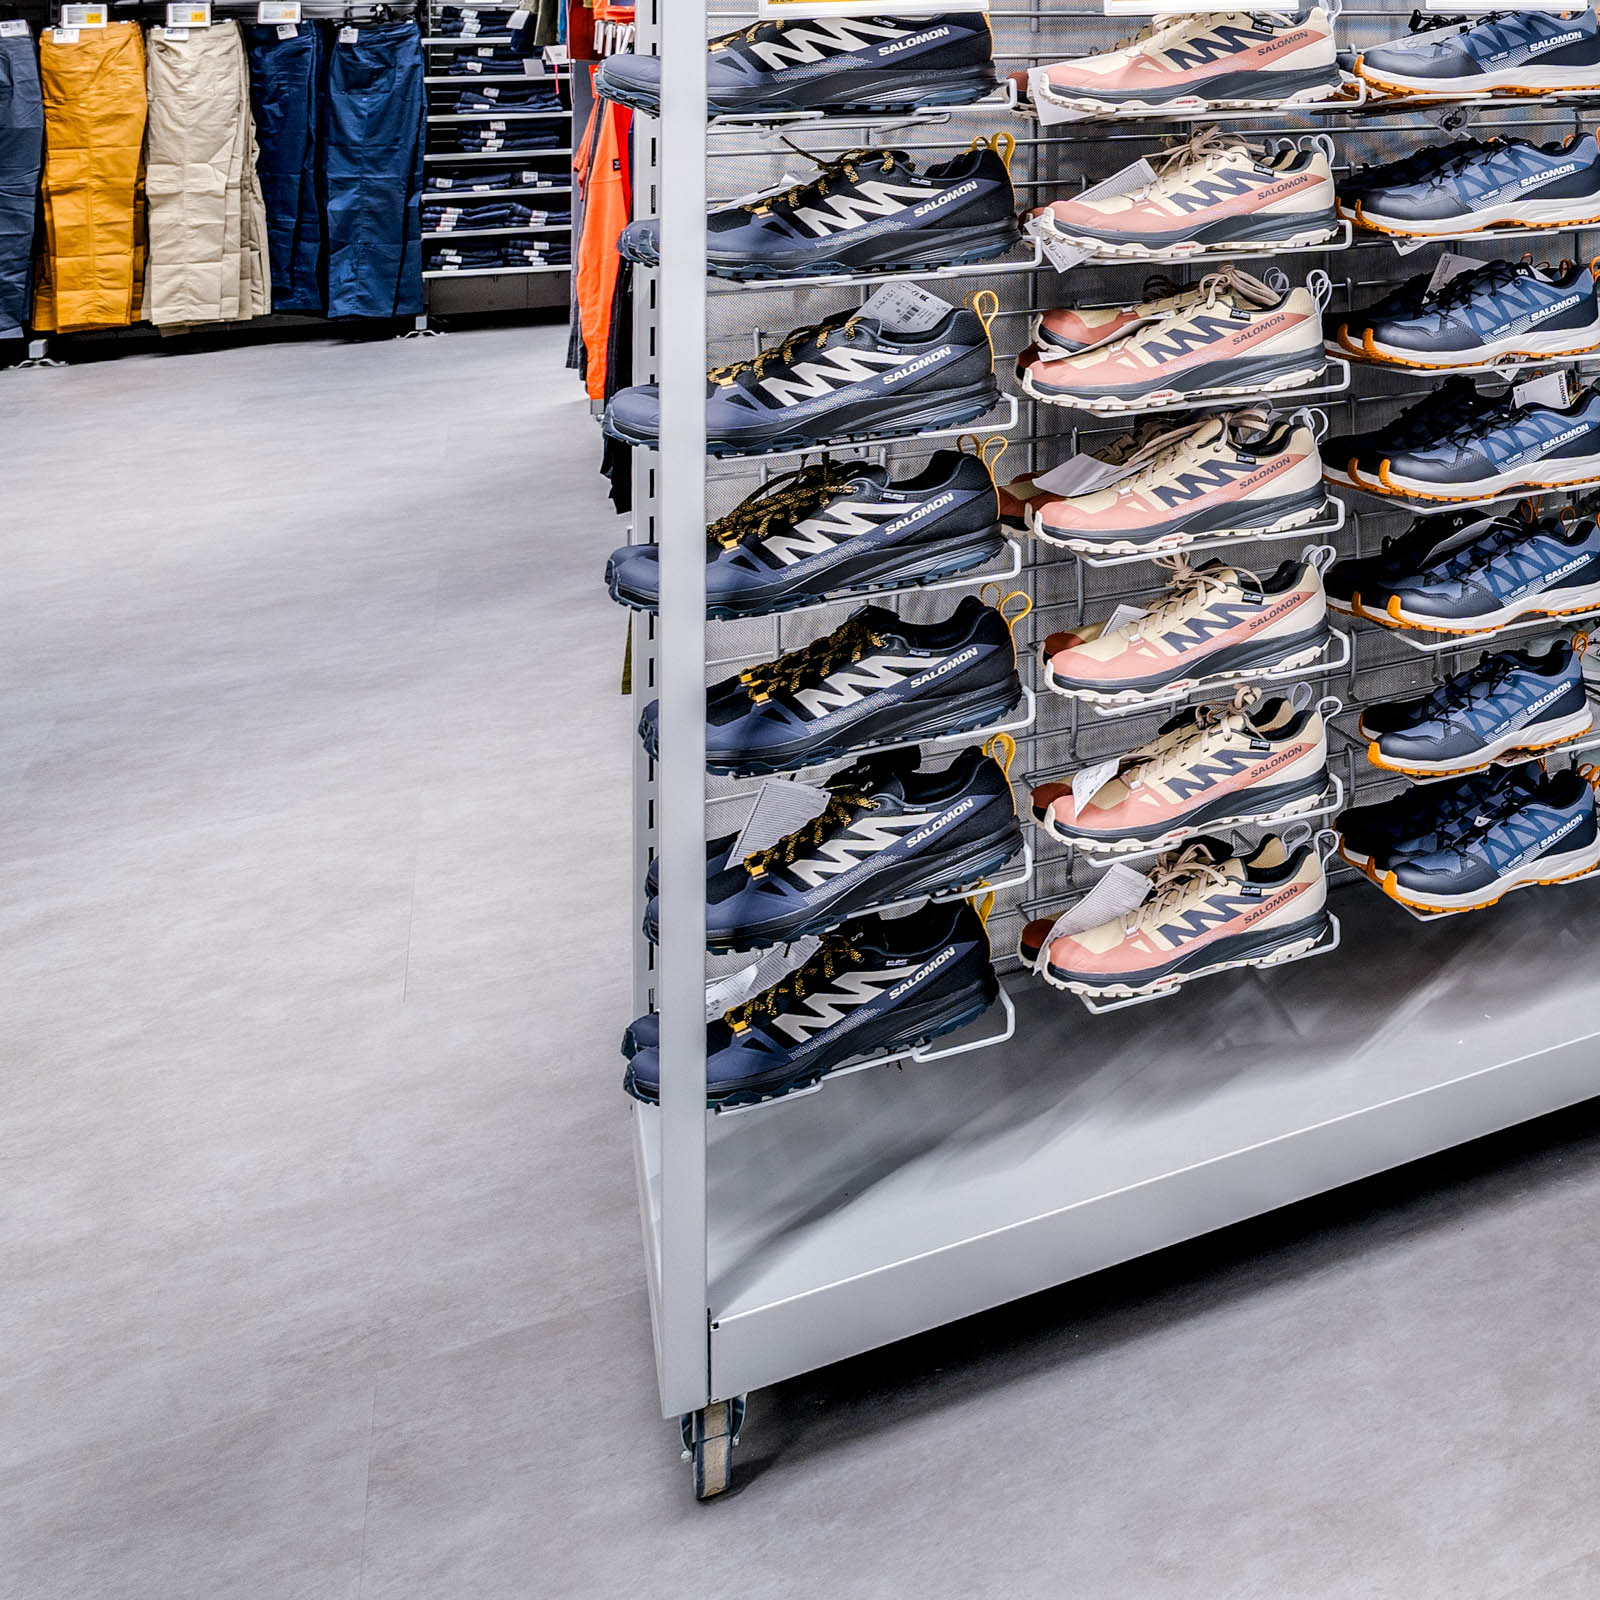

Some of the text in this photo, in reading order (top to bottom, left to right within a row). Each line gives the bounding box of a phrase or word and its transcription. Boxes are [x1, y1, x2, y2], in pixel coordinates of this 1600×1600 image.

[878, 26, 950, 57] SALOMON
[1257, 30, 1309, 57] SALOMON
[1529, 31, 1583, 53] SALOMON
[1257, 175, 1309, 200] SALOMON
[1520, 163, 1576, 188] SALOMON
[914, 180, 979, 217] SALOMON
[1530, 295, 1580, 321] SALOMON
[1232, 314, 1285, 345] SALOMON
[882, 346, 952, 385] SALOMON
[1541, 423, 1589, 451] SALOMON
[1239, 457, 1291, 490] SALOMON
[884, 493, 954, 536] SALOMON
[1544, 554, 1590, 583] SALOMON
[1249, 593, 1301, 631] SALOMON
[910, 646, 979, 688] SALOMON
[1526, 681, 1571, 715] SALOMON
[1250, 745, 1303, 780] SALOMON
[906, 798, 974, 848] SALOMON
[1540, 814, 1583, 848] SALOMON
[1244, 886, 1298, 925] SALOMON
[888, 946, 955, 1001] SALOMON
